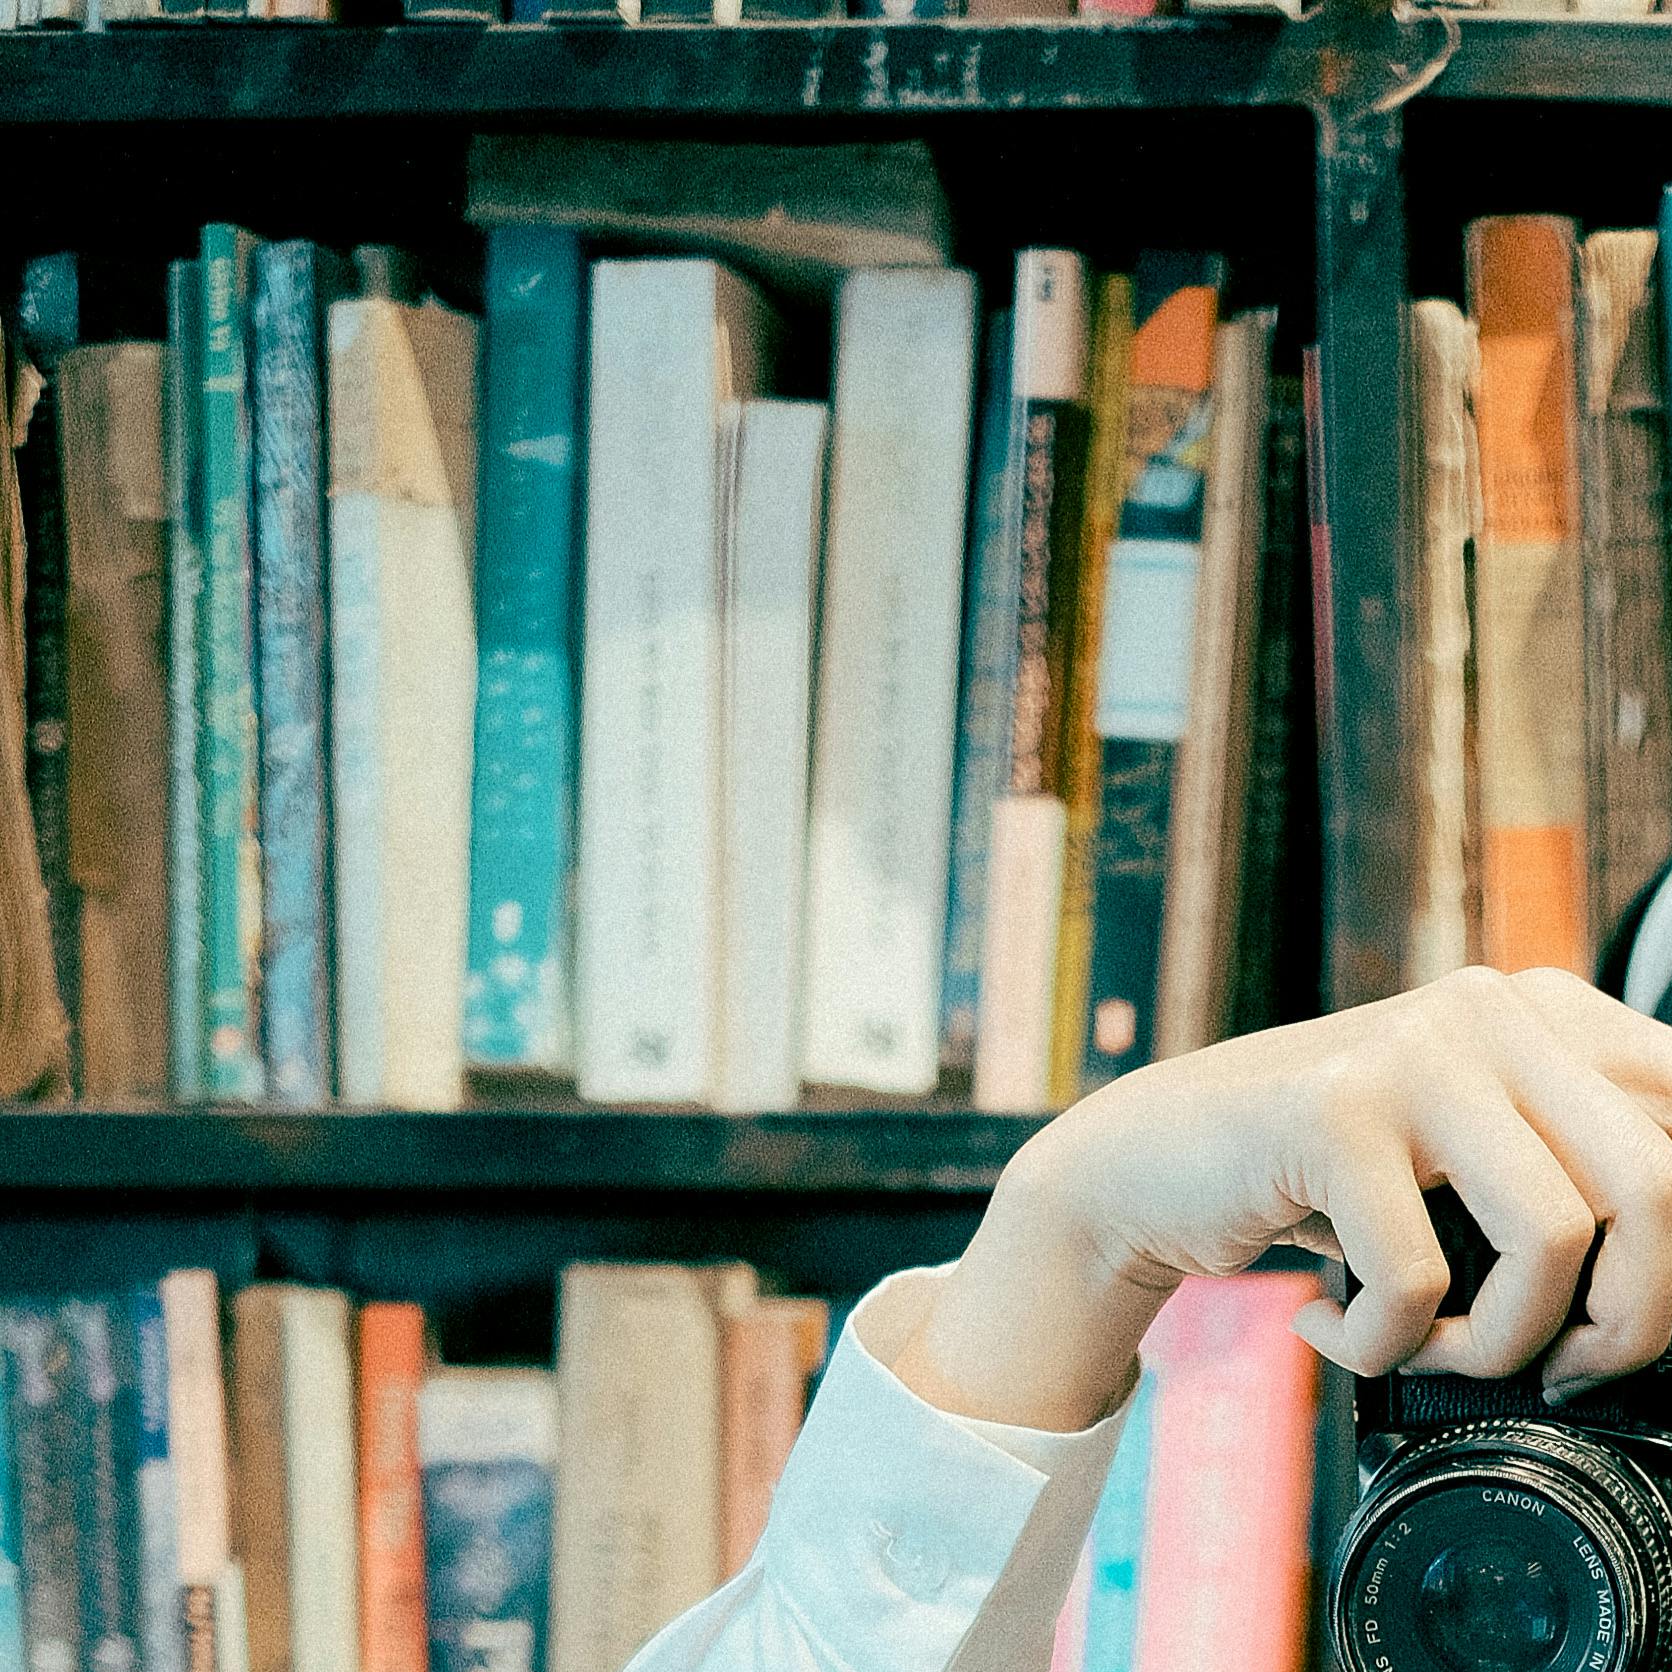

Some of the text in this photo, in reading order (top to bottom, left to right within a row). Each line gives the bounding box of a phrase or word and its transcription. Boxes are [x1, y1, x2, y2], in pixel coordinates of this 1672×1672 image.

[1482, 1489, 1546, 1516] CANON
[1572, 1534, 1605, 1581] LENS
[1364, 1556, 1390, 1606] 50mm
[1364, 1618, 1382, 1646] FD
[1596, 1588, 1616, 1642] MADE
[1588, 1651, 1606, 1671] IN
